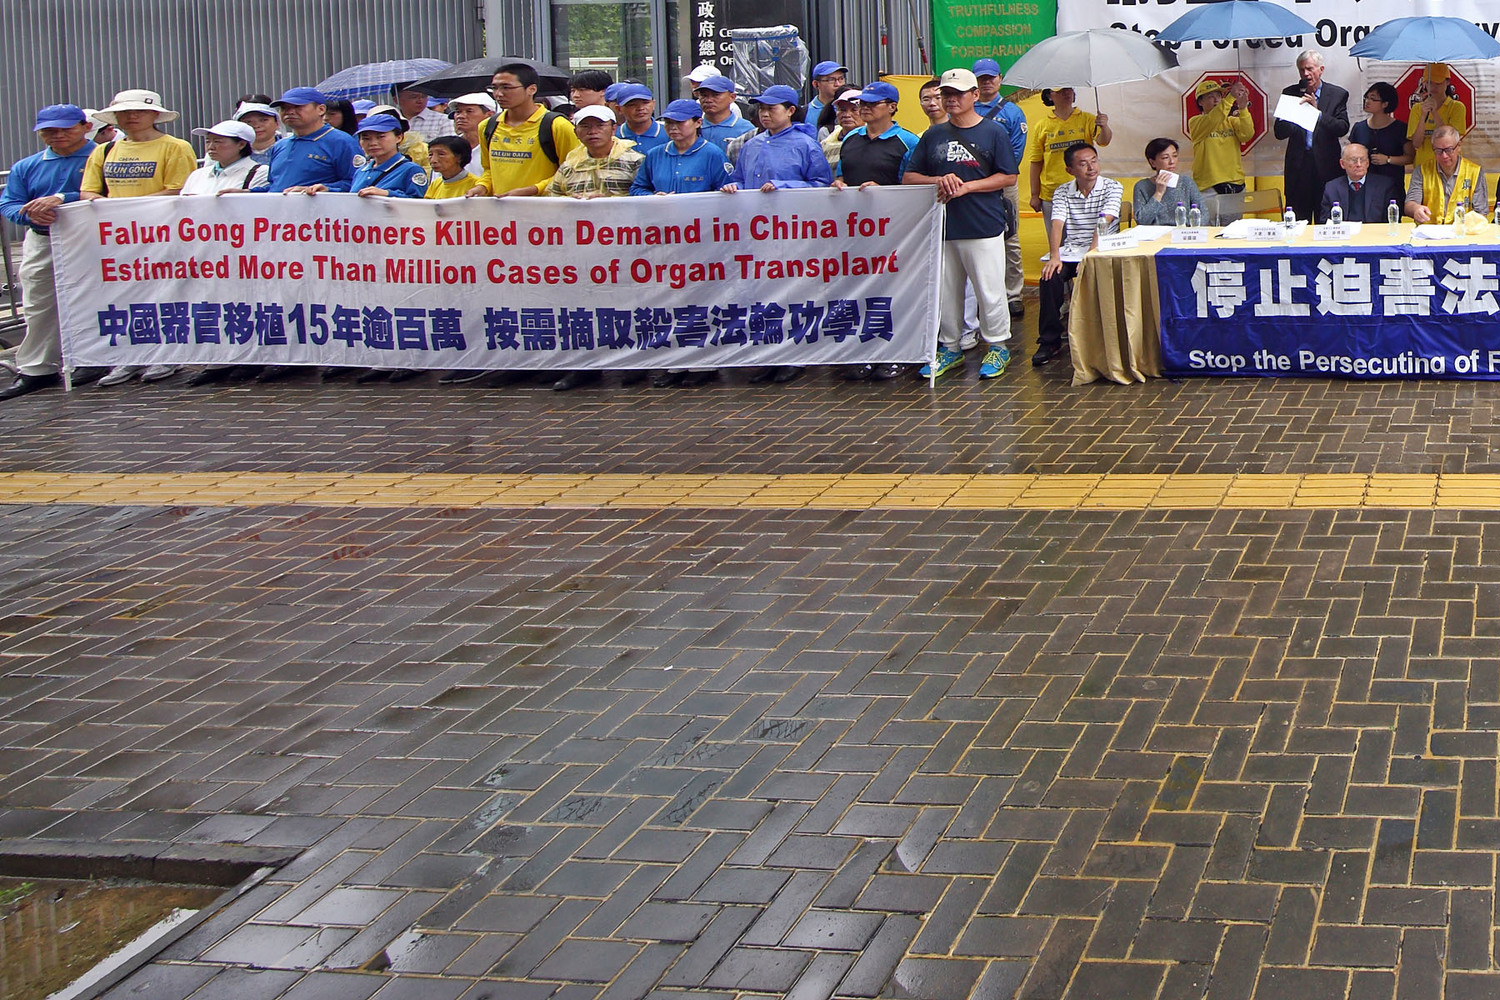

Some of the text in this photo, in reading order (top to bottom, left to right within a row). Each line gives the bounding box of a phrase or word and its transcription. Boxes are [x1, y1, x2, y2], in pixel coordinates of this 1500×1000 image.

[949, 3, 1039, 17] TRUTHFULNESS
[956, 23, 1031, 38] COMPASSION
[951, 43, 1035, 59] FORBEARANC
[99, 212, 890, 248] Falun Gong Practitioners Killed on Demand in China for
[102, 251, 898, 288] Estimated More Than Million Cases of Organ Transplant
[97, 296, 894, 351] 中國器官移植15年逾百萬 按需摘取殺害法輪功學員
[1189, 350, 1245, 371] Stop
[1253, 350, 1290, 370] the
[1299, 350, 1445, 375] Persecuting
[1455, 350, 1479, 373] of
